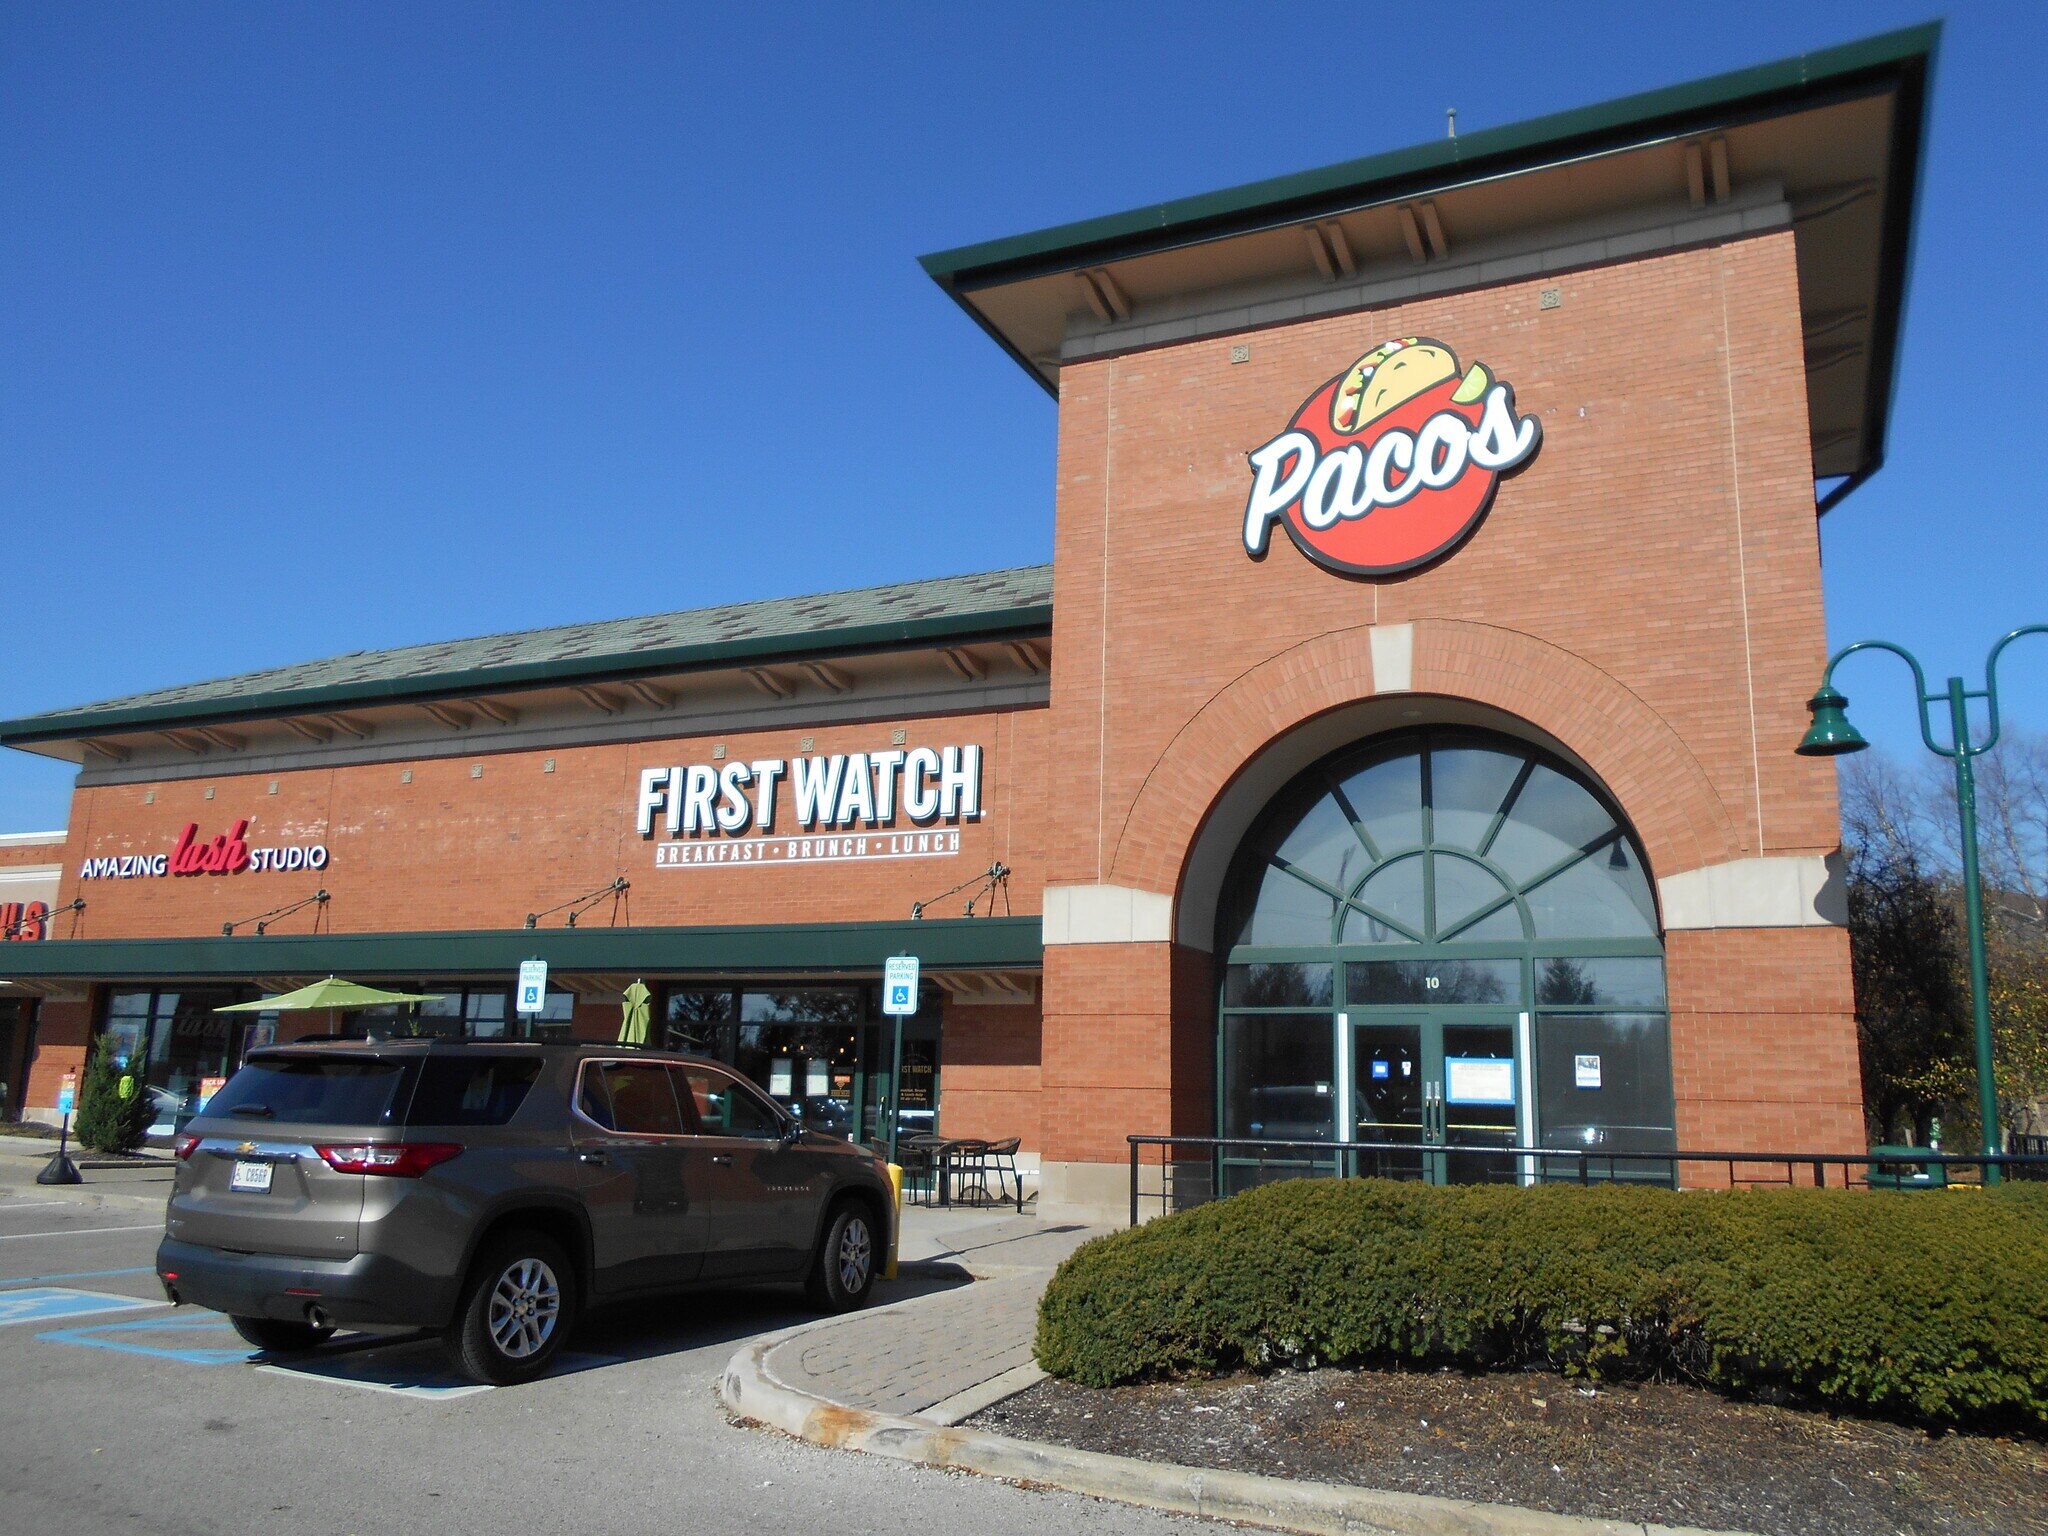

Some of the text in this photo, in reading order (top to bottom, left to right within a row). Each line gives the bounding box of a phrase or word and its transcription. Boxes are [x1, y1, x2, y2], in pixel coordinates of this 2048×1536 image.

[636, 758, 786, 837] FIRST
[80, 818, 329, 879] AMAZING lash STUDIO
[656, 833, 961, 864] BREAKFAST BRUNCH LUNCH
[1425, 976, 1440, 989] 10
